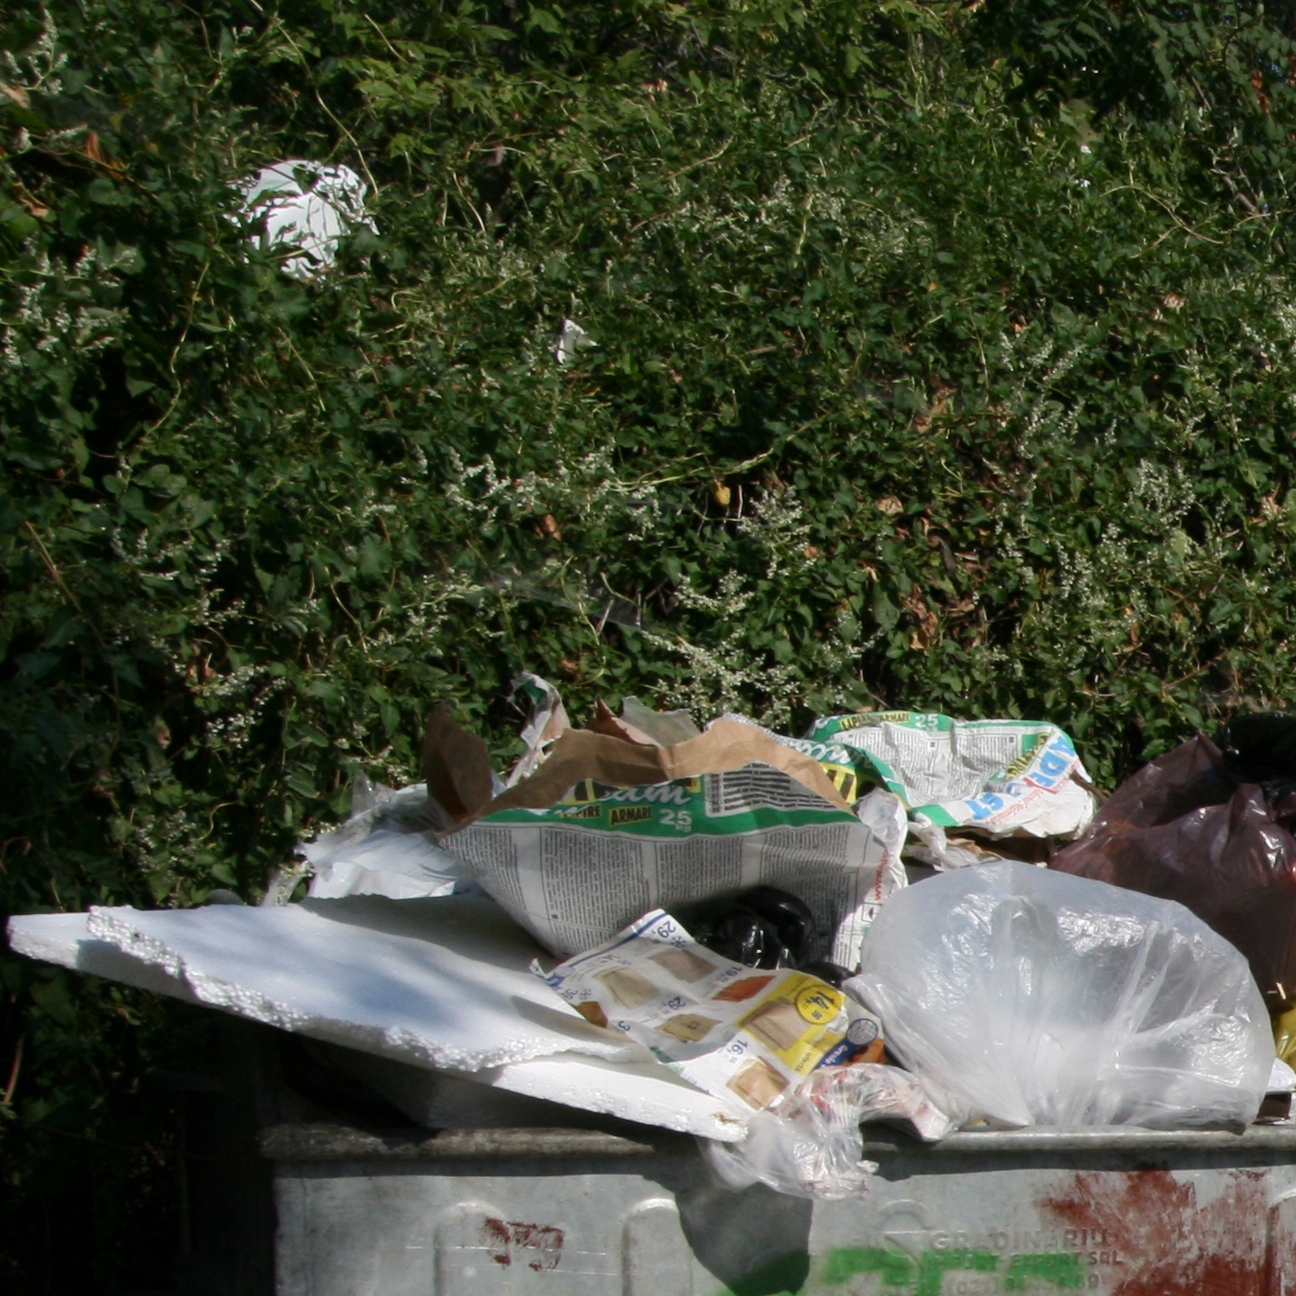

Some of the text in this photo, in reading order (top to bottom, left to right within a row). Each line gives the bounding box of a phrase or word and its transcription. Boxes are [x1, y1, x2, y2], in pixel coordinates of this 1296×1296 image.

[915, 713, 938, 727] 25
[611, 806, 651, 826] ARMARE
[659, 808, 692, 826] 25
